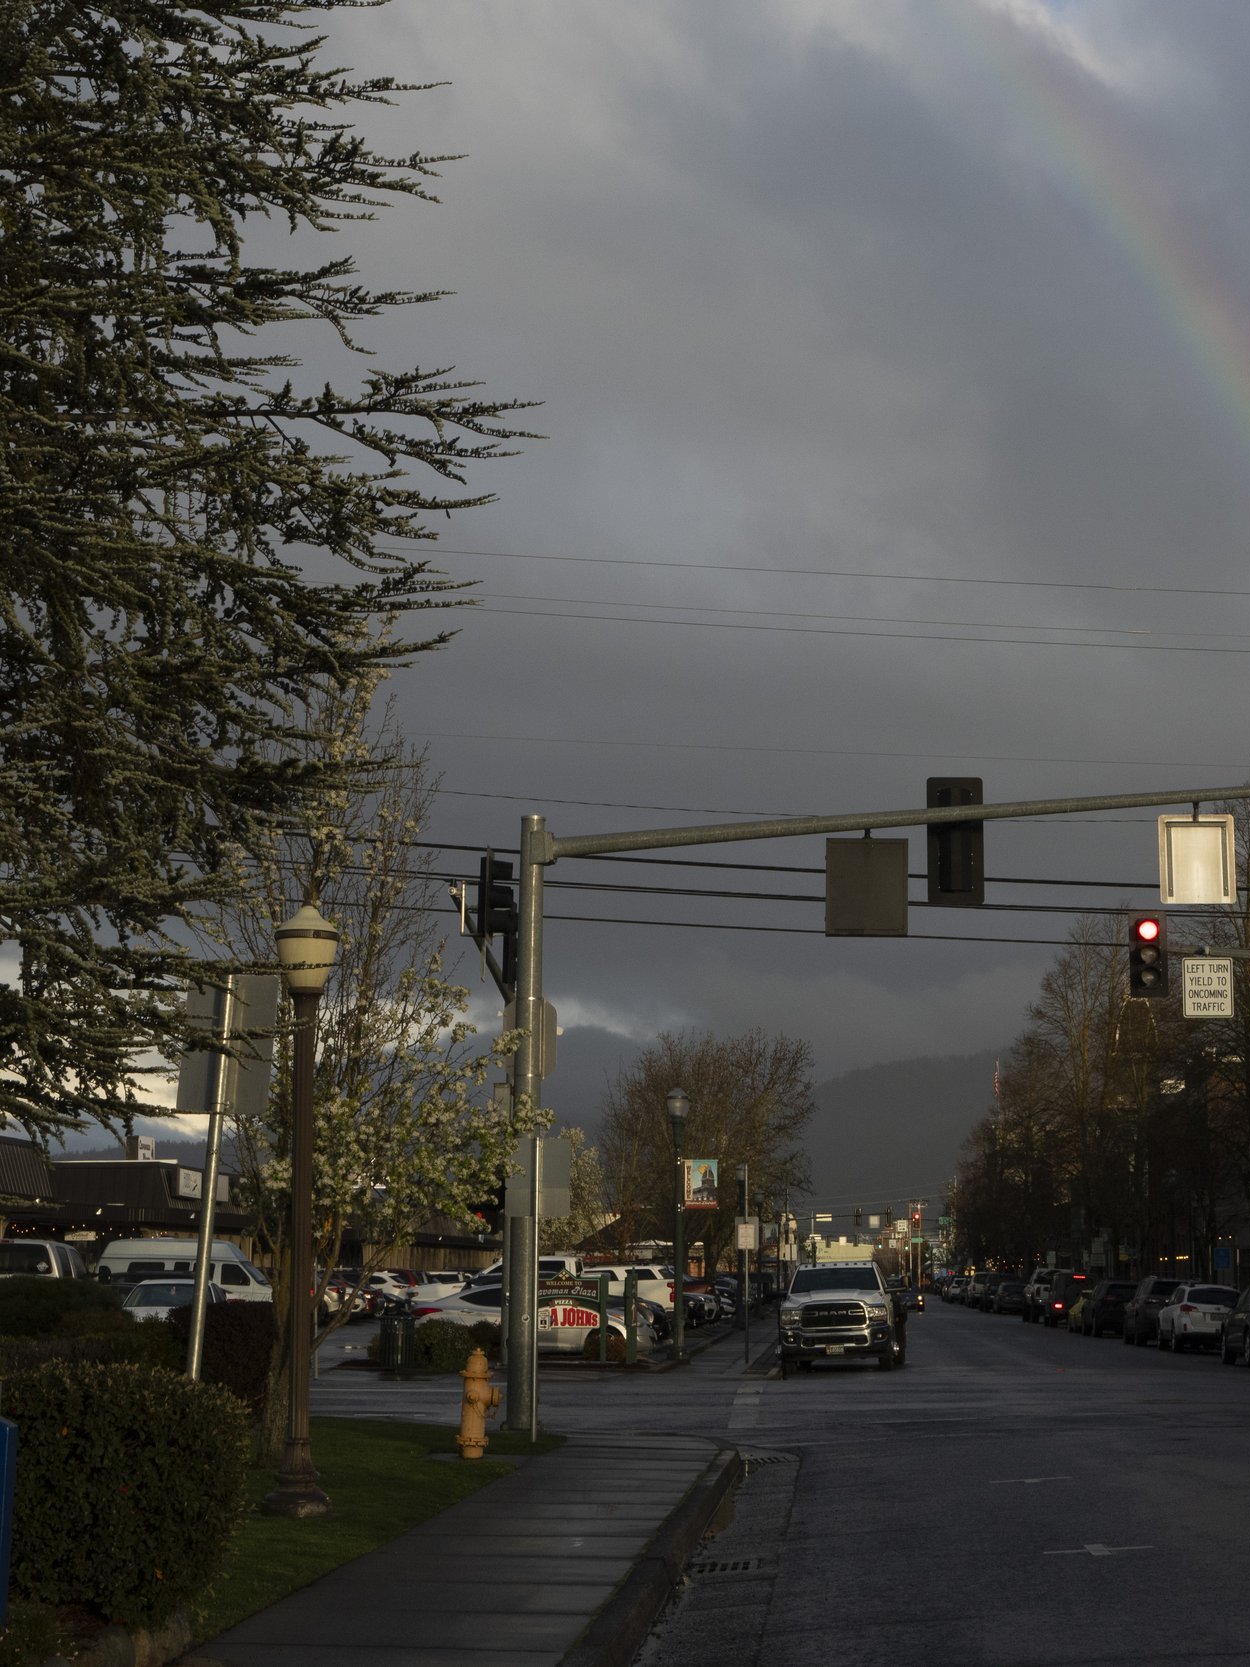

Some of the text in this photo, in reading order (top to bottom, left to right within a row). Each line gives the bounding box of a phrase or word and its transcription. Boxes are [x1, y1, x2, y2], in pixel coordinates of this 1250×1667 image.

[1186, 964, 1229, 974] LEFT TURN
[1189, 976, 1227, 986] YIELD TO
[1188, 989, 1228, 999] ONCOMING
[1192, 1002, 1225, 1012] TRAFFIC
[571, 1286, 597, 1297] Plaza
[560, 1307, 598, 1327] JOHNS
